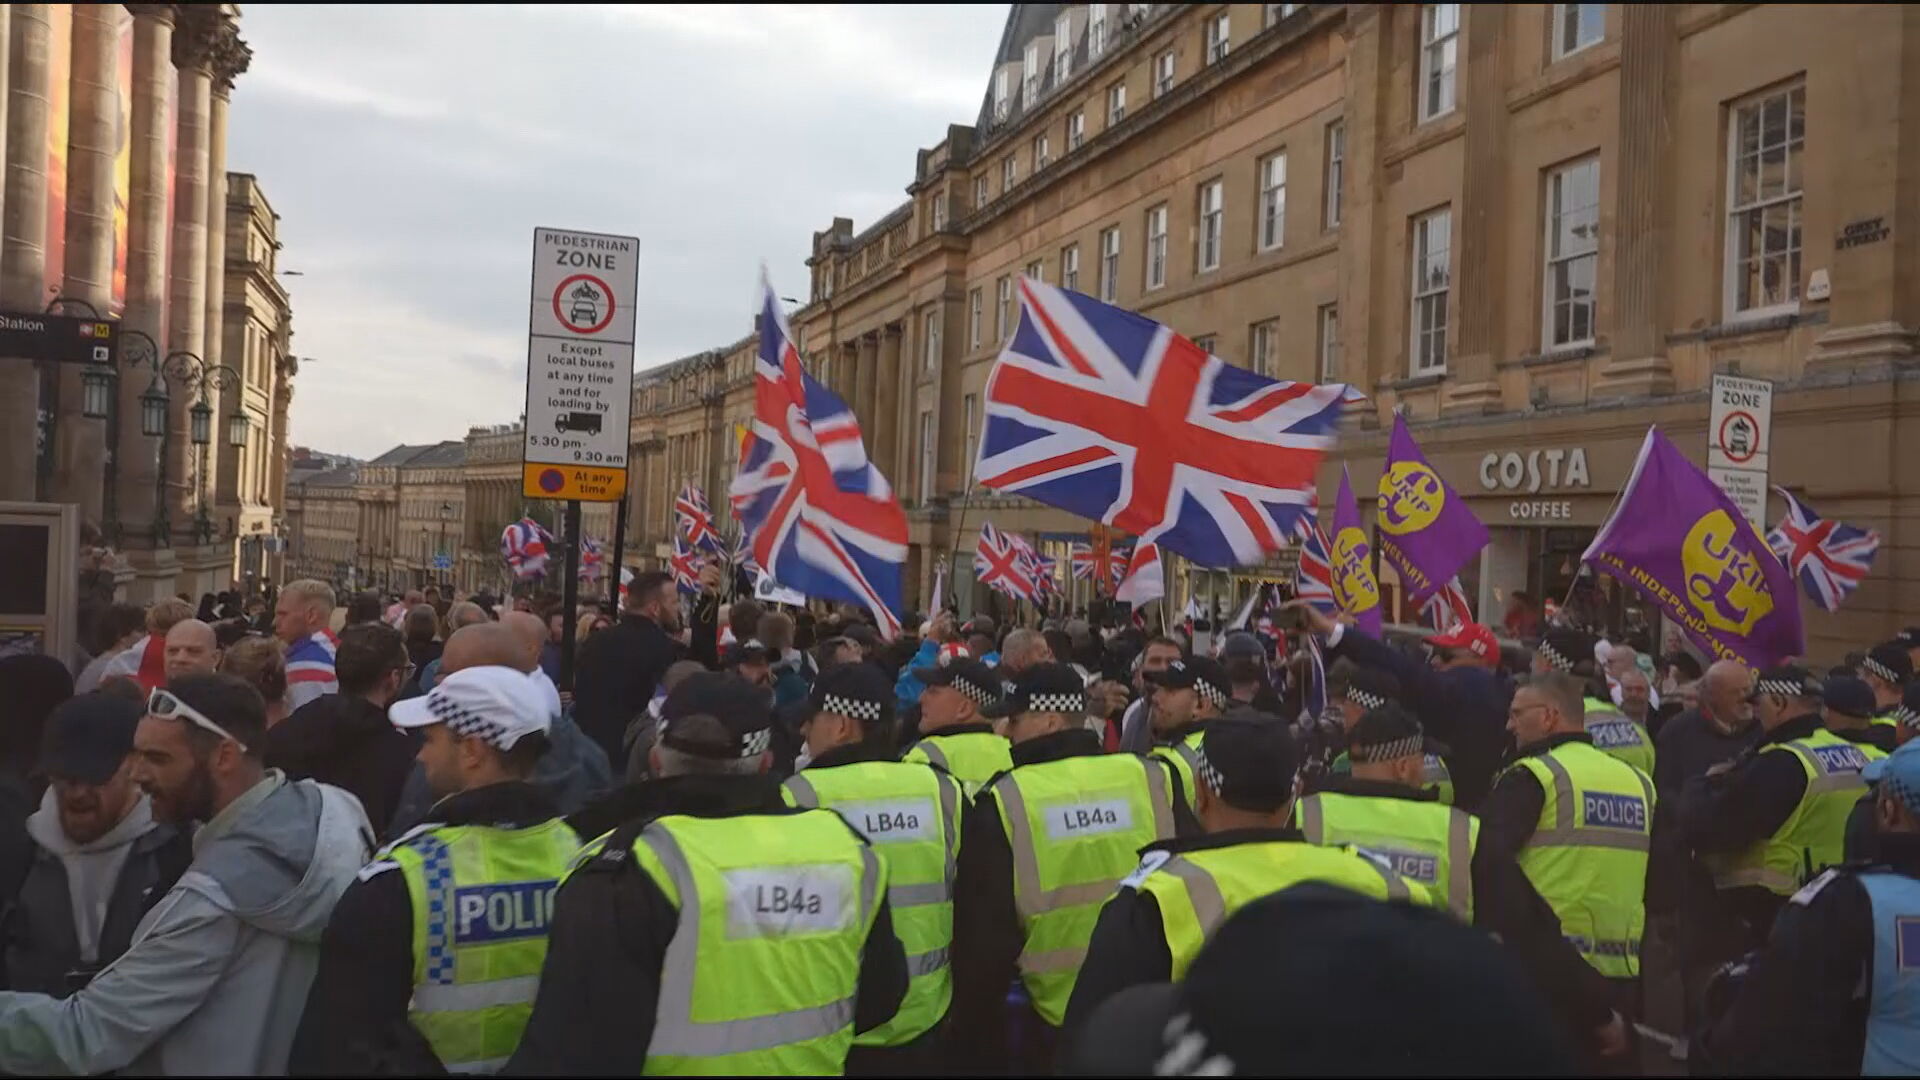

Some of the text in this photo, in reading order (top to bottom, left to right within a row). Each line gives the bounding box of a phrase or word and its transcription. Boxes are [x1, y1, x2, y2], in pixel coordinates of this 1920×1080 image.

[544, 233, 629, 252] PEDESTRIAN
[556, 249, 616, 270] ZONE
[561, 342, 602, 357] Except
[547, 353, 615, 370] local buses
[547, 370, 614, 385] at any time
[1716, 379, 1769, 393] PEDESTRIAN
[559, 386, 601, 399] and for
[1722, 391, 1760, 408] ZONE
[547, 396, 610, 413] loading by
[530, 435, 560, 447] 5.30
[574, 450, 624, 464] 9.30 am
[575, 471, 613, 485] At any
[1480, 447, 1590, 493] COSTA
[580, 484, 606, 494] time
[1390, 472, 1431, 512] UKIP
[1510, 501, 1571, 518] COFFEE
[1339, 538, 1375, 593] UKIP
[1063, 808, 1117, 830] LB4a
[1584, 796, 1644, 826] POLICE
[865, 812, 919, 834] LB4a
[756, 886, 821, 914] LB4a
